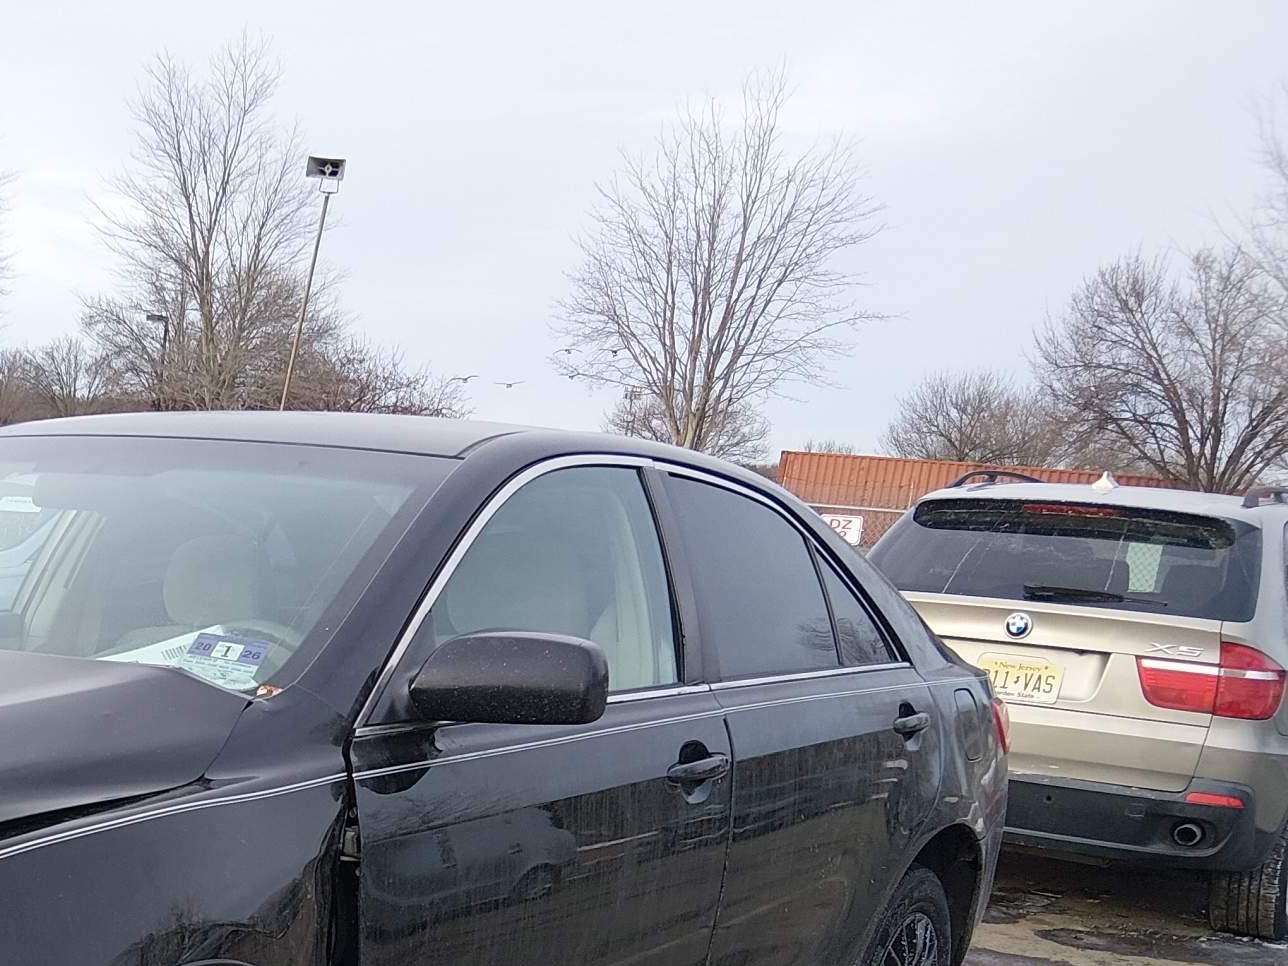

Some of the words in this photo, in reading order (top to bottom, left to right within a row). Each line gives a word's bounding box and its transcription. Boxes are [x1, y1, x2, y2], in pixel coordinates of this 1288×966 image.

[830, 519, 853, 530] DZ
[220, 645, 233, 658] 1
[242, 650, 262, 661] 26
[1143, 642, 1205, 658] X5
[999, 661, 1017, 669] New
[1018, 664, 1041, 672] Jersey
[1023, 672, 1056, 694] VAS
